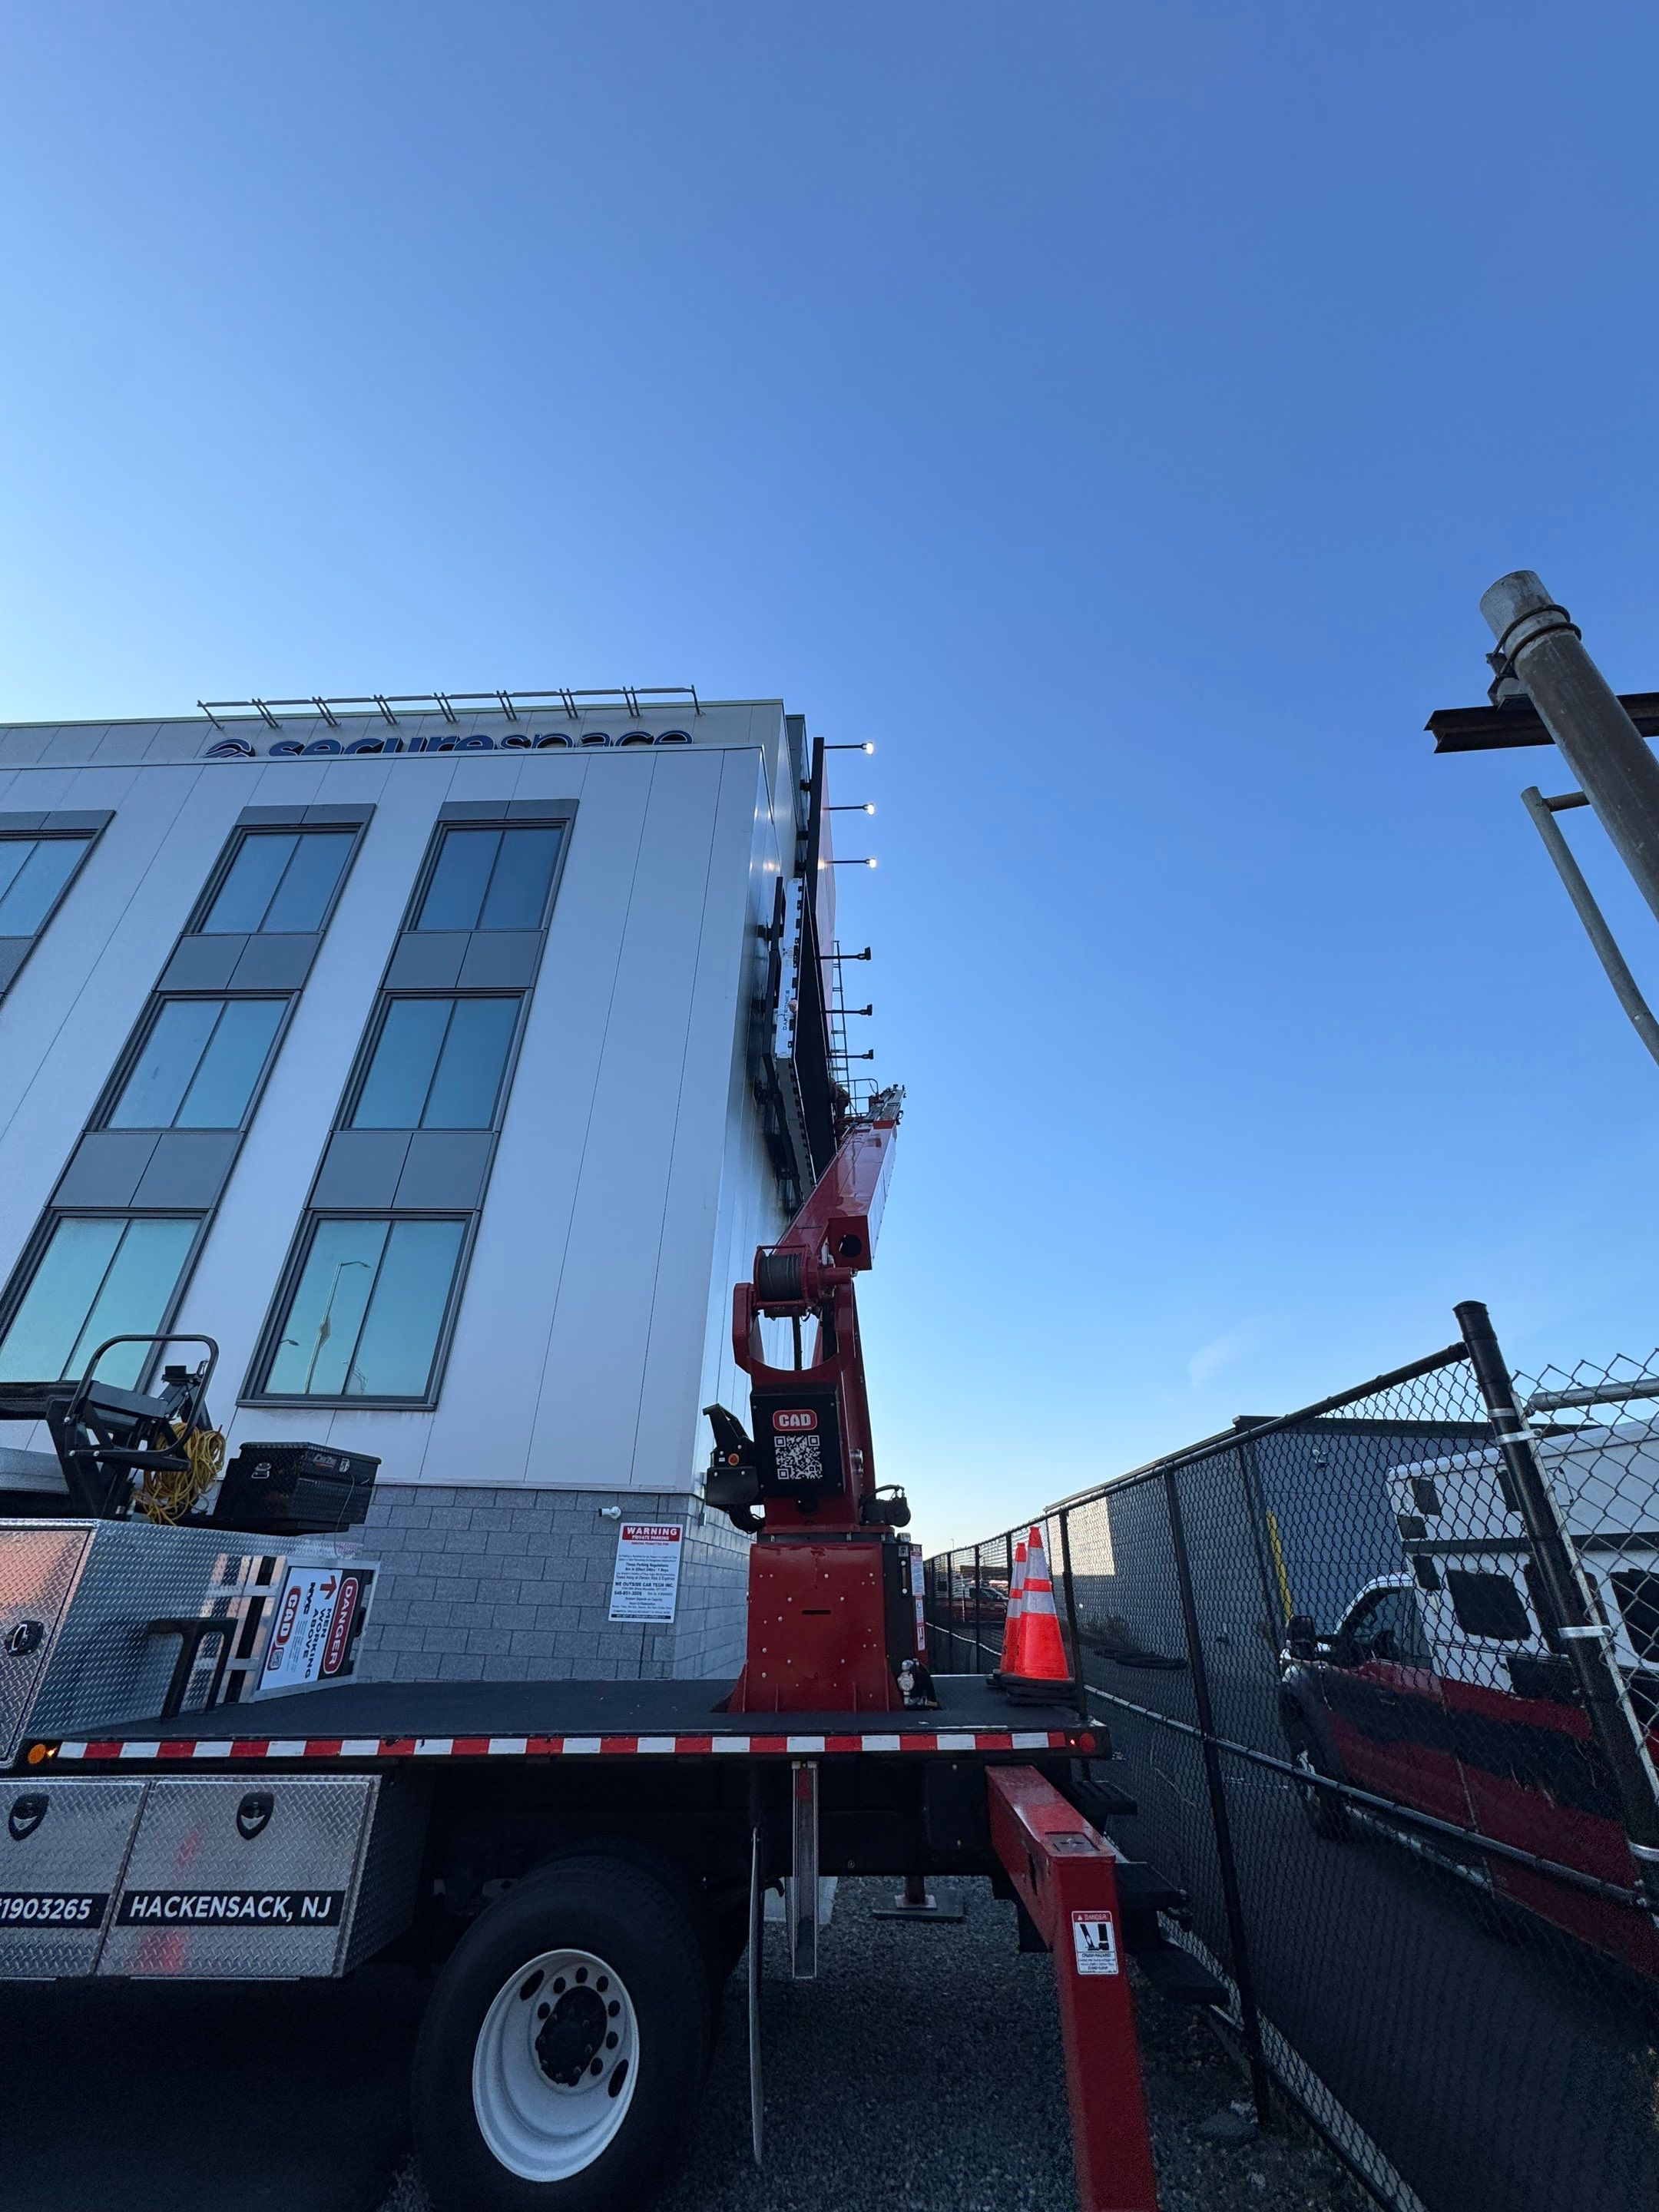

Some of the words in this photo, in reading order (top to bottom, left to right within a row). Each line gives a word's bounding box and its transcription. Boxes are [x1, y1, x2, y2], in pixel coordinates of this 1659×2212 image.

[779, 1414, 811, 1427] CAD
[280, 1594, 298, 1637] CAD
[303, 1609, 318, 1659] ABOVE
[320, 1608, 332, 1638] MEN
[328, 1586, 353, 1665] DANGER
[305, 1608, 326, 1678] WORKING
[129, 1896, 293, 1922] HACKENSACK,
[301, 1896, 332, 1919] NJ
